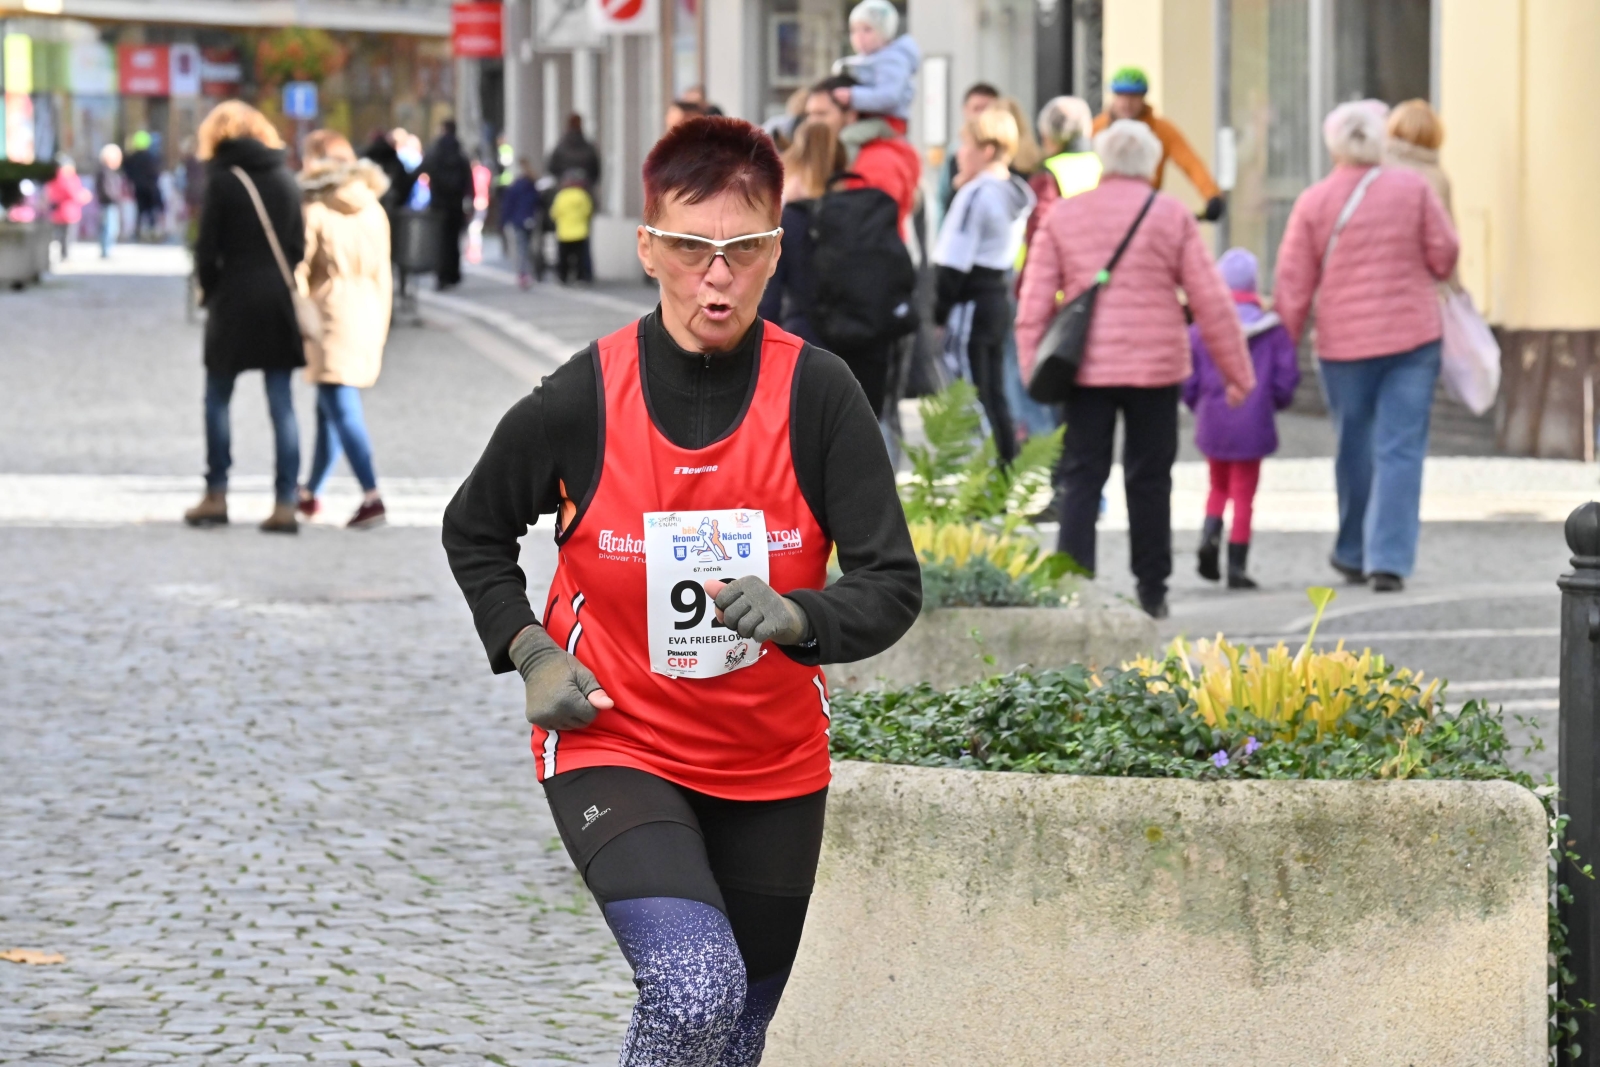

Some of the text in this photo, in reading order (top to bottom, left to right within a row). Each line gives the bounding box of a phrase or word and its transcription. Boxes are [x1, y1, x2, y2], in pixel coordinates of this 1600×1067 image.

[673, 464, 718, 475] newline
[672, 531, 752, 543] Hronov Náchod
[598, 552, 630, 562] pivovar
[670, 577, 738, 631] 9
[668, 636, 688, 645] EVA
[667, 657, 698, 669] CUP
